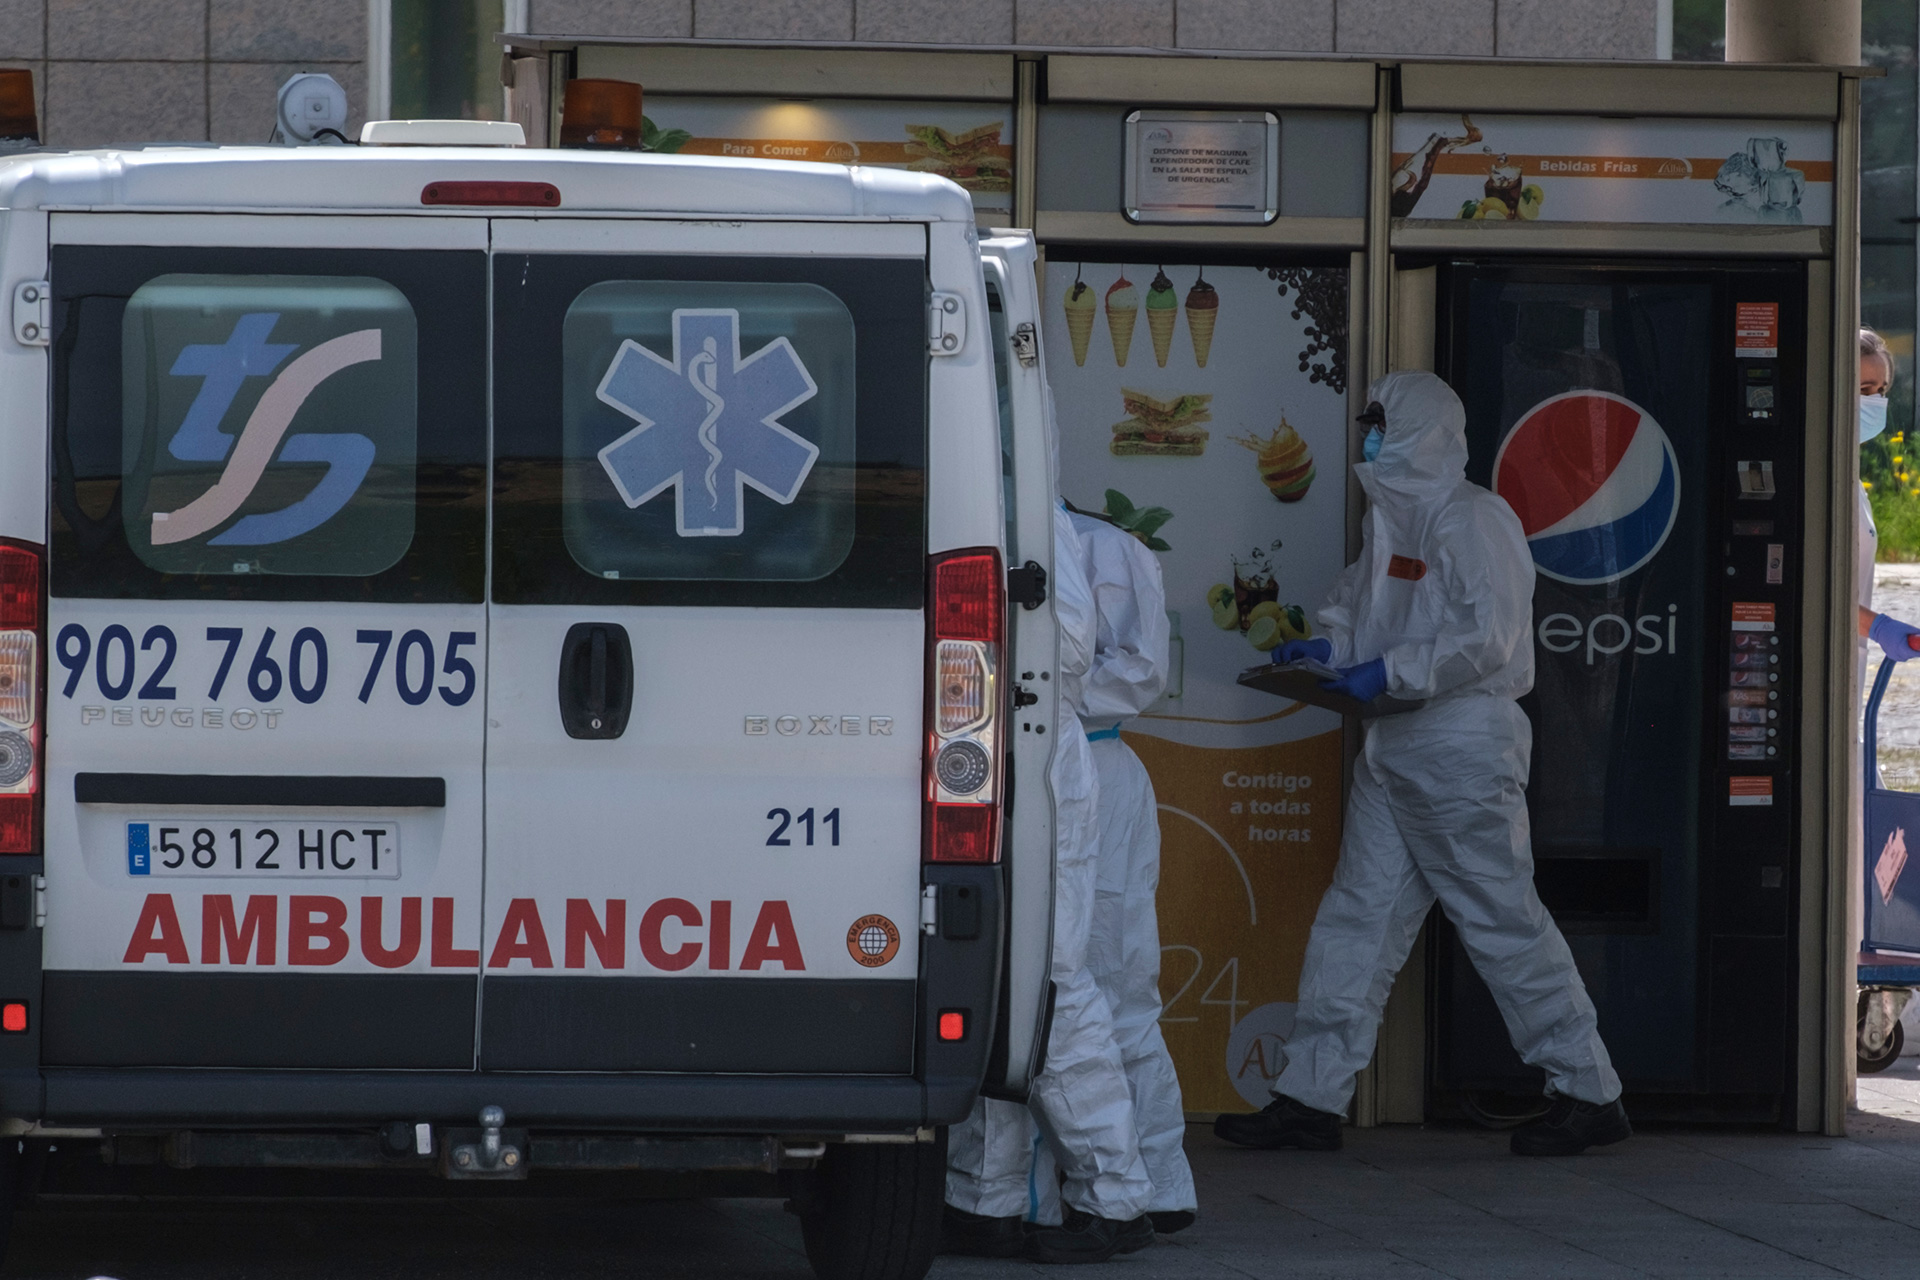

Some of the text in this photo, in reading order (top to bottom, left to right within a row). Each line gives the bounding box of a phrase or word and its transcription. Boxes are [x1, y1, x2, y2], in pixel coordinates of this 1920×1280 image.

[722, 143, 755, 155] Para
[762, 144, 809, 156] Comer
[1150, 157, 1214, 165] EXPENDEDORA
[1153, 148, 1190, 156] DISPONE
[1204, 167, 1215, 175] DE
[1540, 160, 1597, 172] Bebidas
[1538, 603, 1678, 665] epsi
[56, 623, 477, 706] 902 760 705
[81, 705, 284, 730] PEUGEOT
[744, 714, 895, 737] BOXER
[1222, 771, 1312, 794] Contigo
[1230, 799, 1311, 815] a todas
[766, 808, 840, 846] 211
[1248, 825, 1311, 842] horas
[159, 828, 387, 870] 5812 HCT
[133, 855, 145, 867] E
[122, 893, 807, 972] AMBULANCIA
[848, 916, 898, 943] EMERGENCIA
[861, 955, 885, 965] 2000
[1157, 945, 1250, 1034] 24
